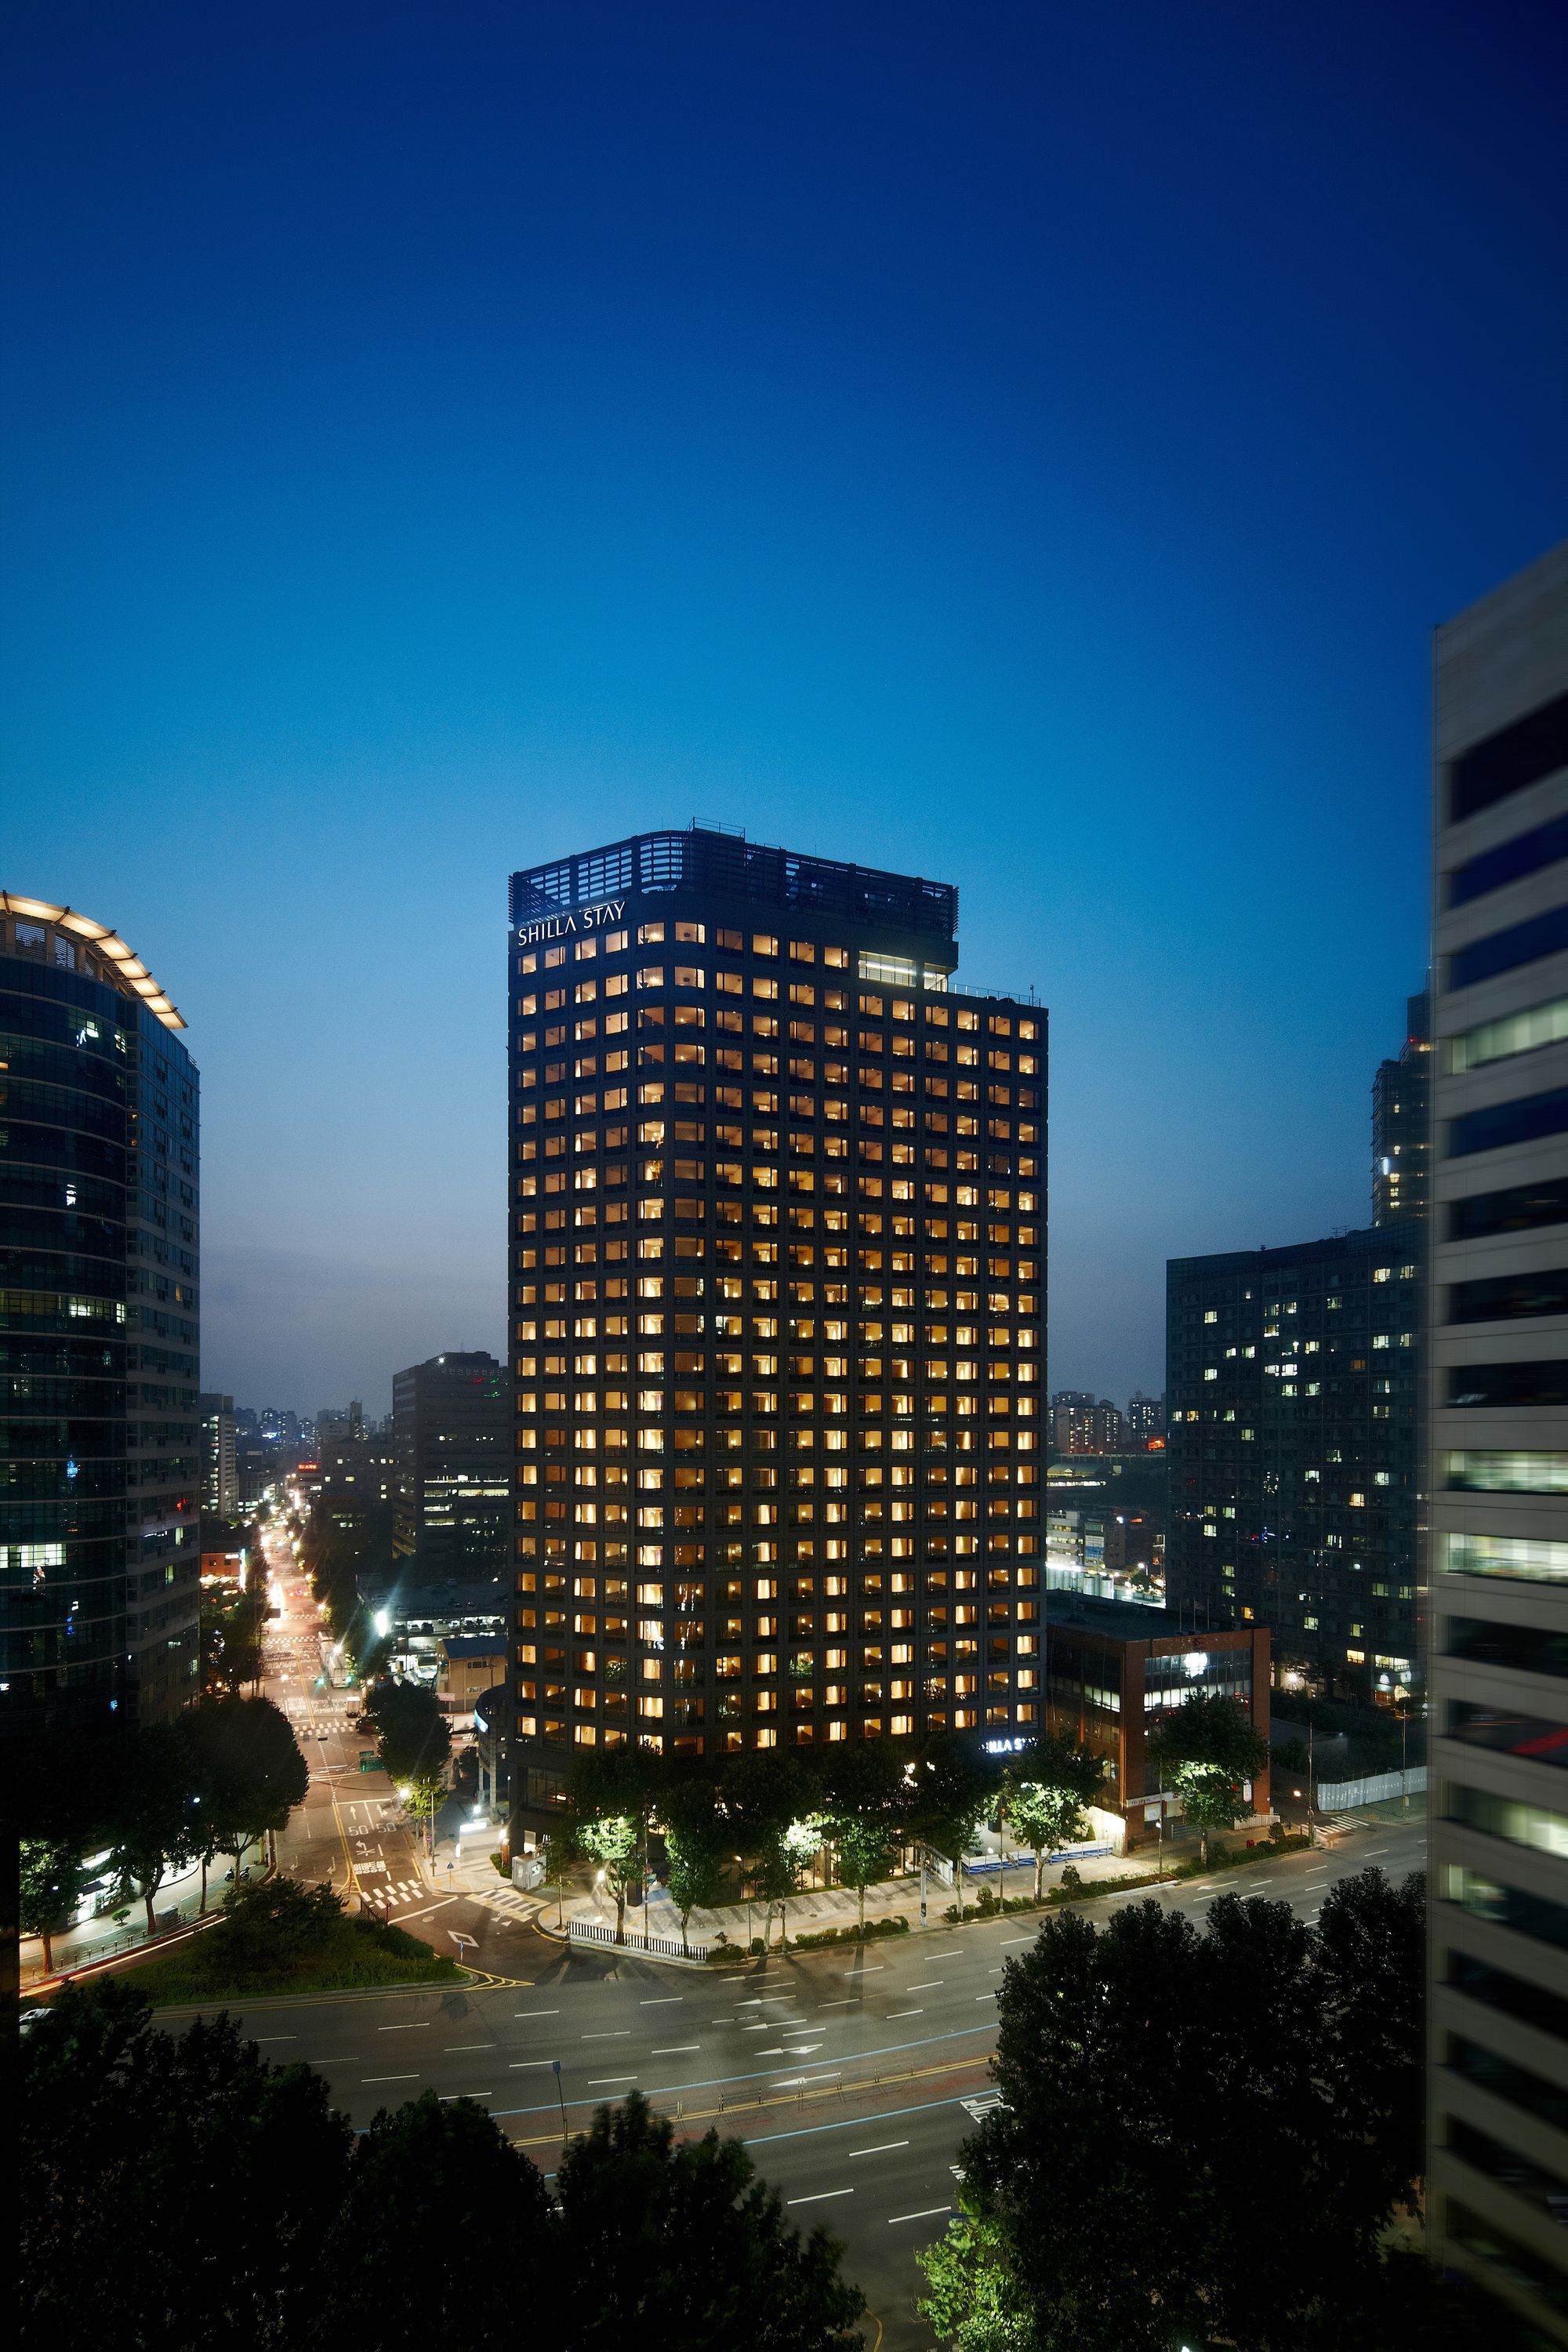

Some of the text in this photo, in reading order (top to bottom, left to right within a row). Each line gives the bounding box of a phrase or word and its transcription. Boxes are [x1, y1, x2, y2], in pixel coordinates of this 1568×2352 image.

[518, 902, 625, 946] SHILLA STAY
[348, 1824, 369, 1836] 50
[376, 1822, 397, 1833] 50
